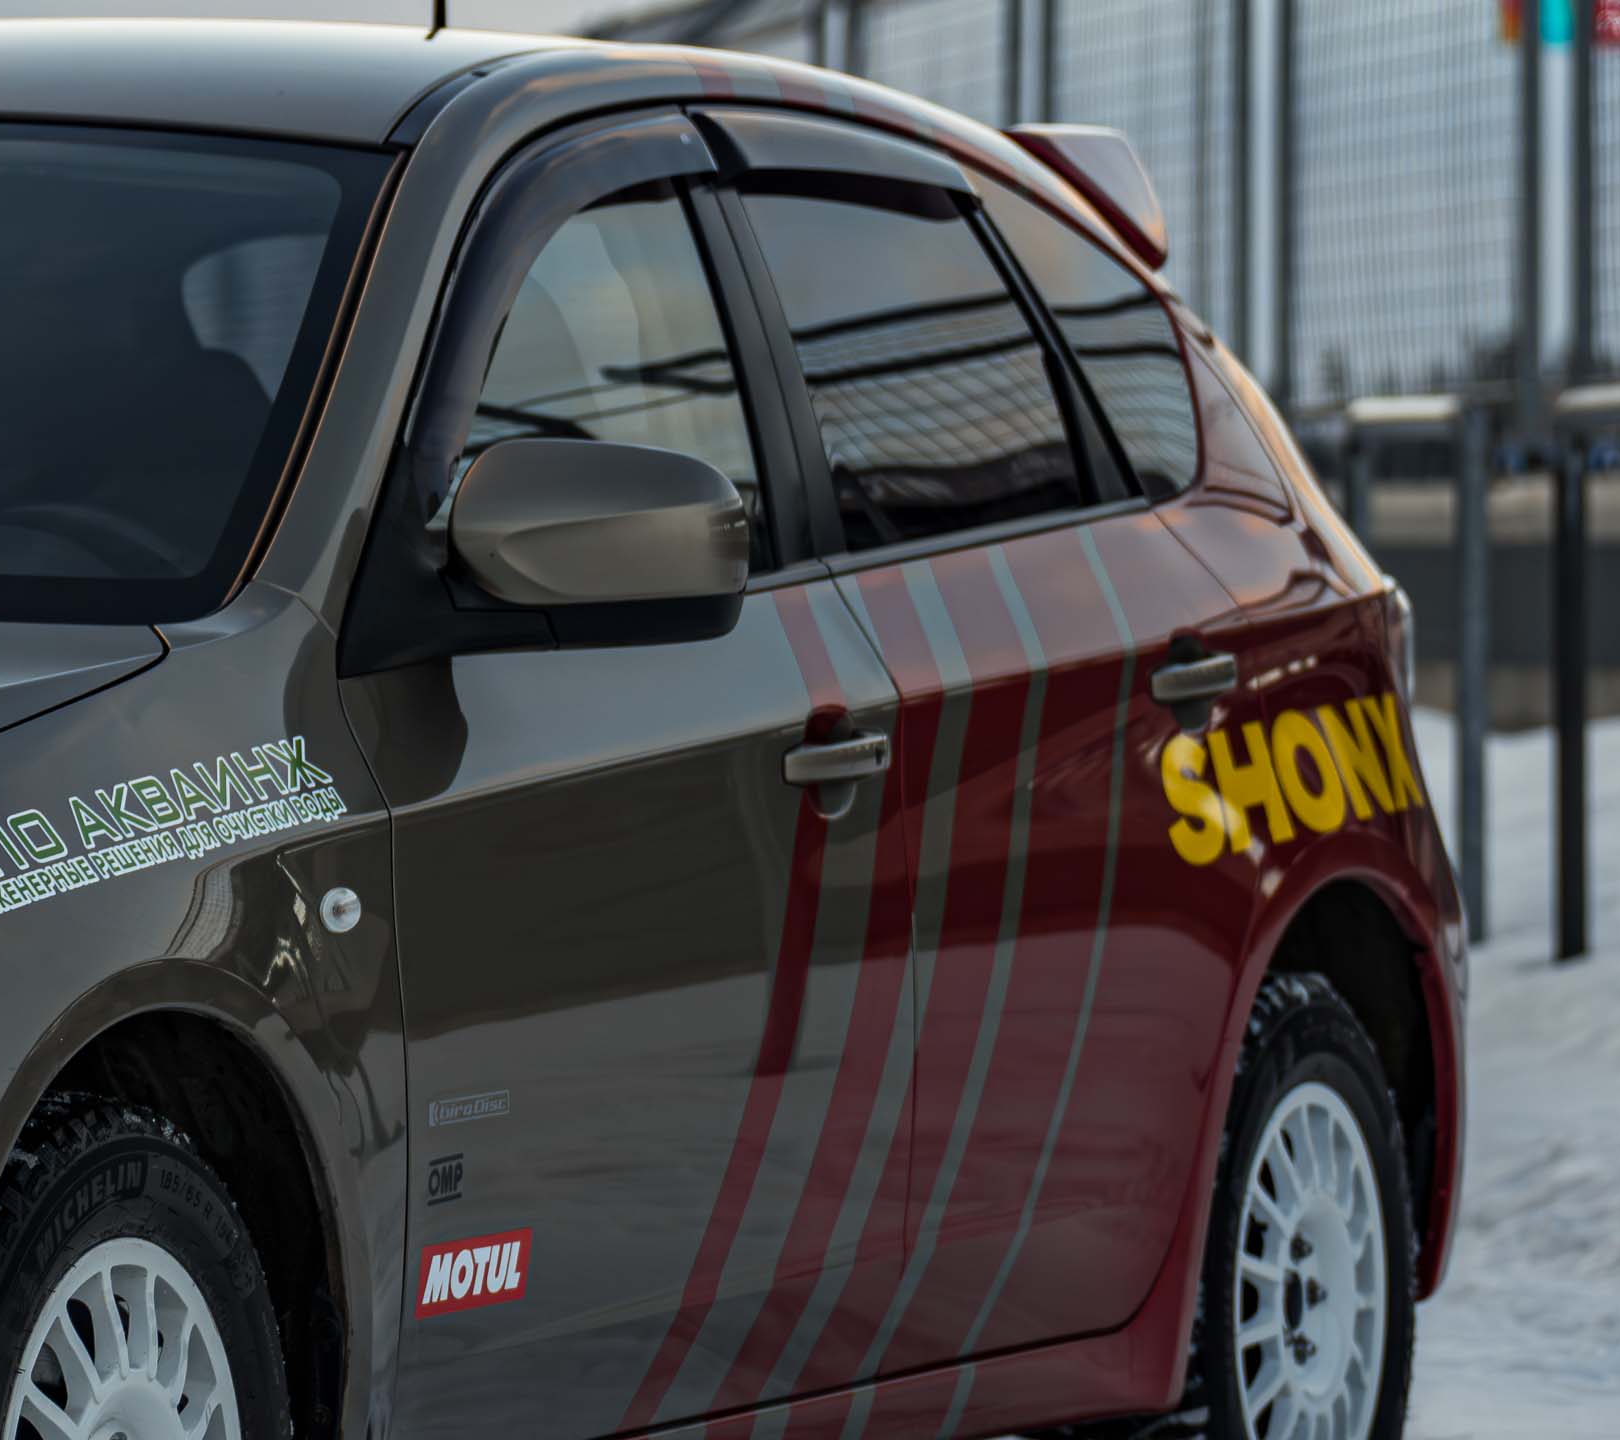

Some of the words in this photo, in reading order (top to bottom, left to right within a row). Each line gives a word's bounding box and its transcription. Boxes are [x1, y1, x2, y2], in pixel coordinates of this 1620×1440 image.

[68, 735, 334, 850] АКВАИНЖ
[1160, 691, 1426, 867] SHONX
[87, 830, 184, 878] РЕШЕНИЯ
[176, 820, 216, 859] ДЛЯ
[212, 798, 300, 844] ОЧИСТКИ
[290, 786, 348, 823] ВОДЫ
[35, 1160, 144, 1262] MICHELIN
[428, 1163, 463, 1197] OMP
[421, 1241, 521, 1305] MOTUL
